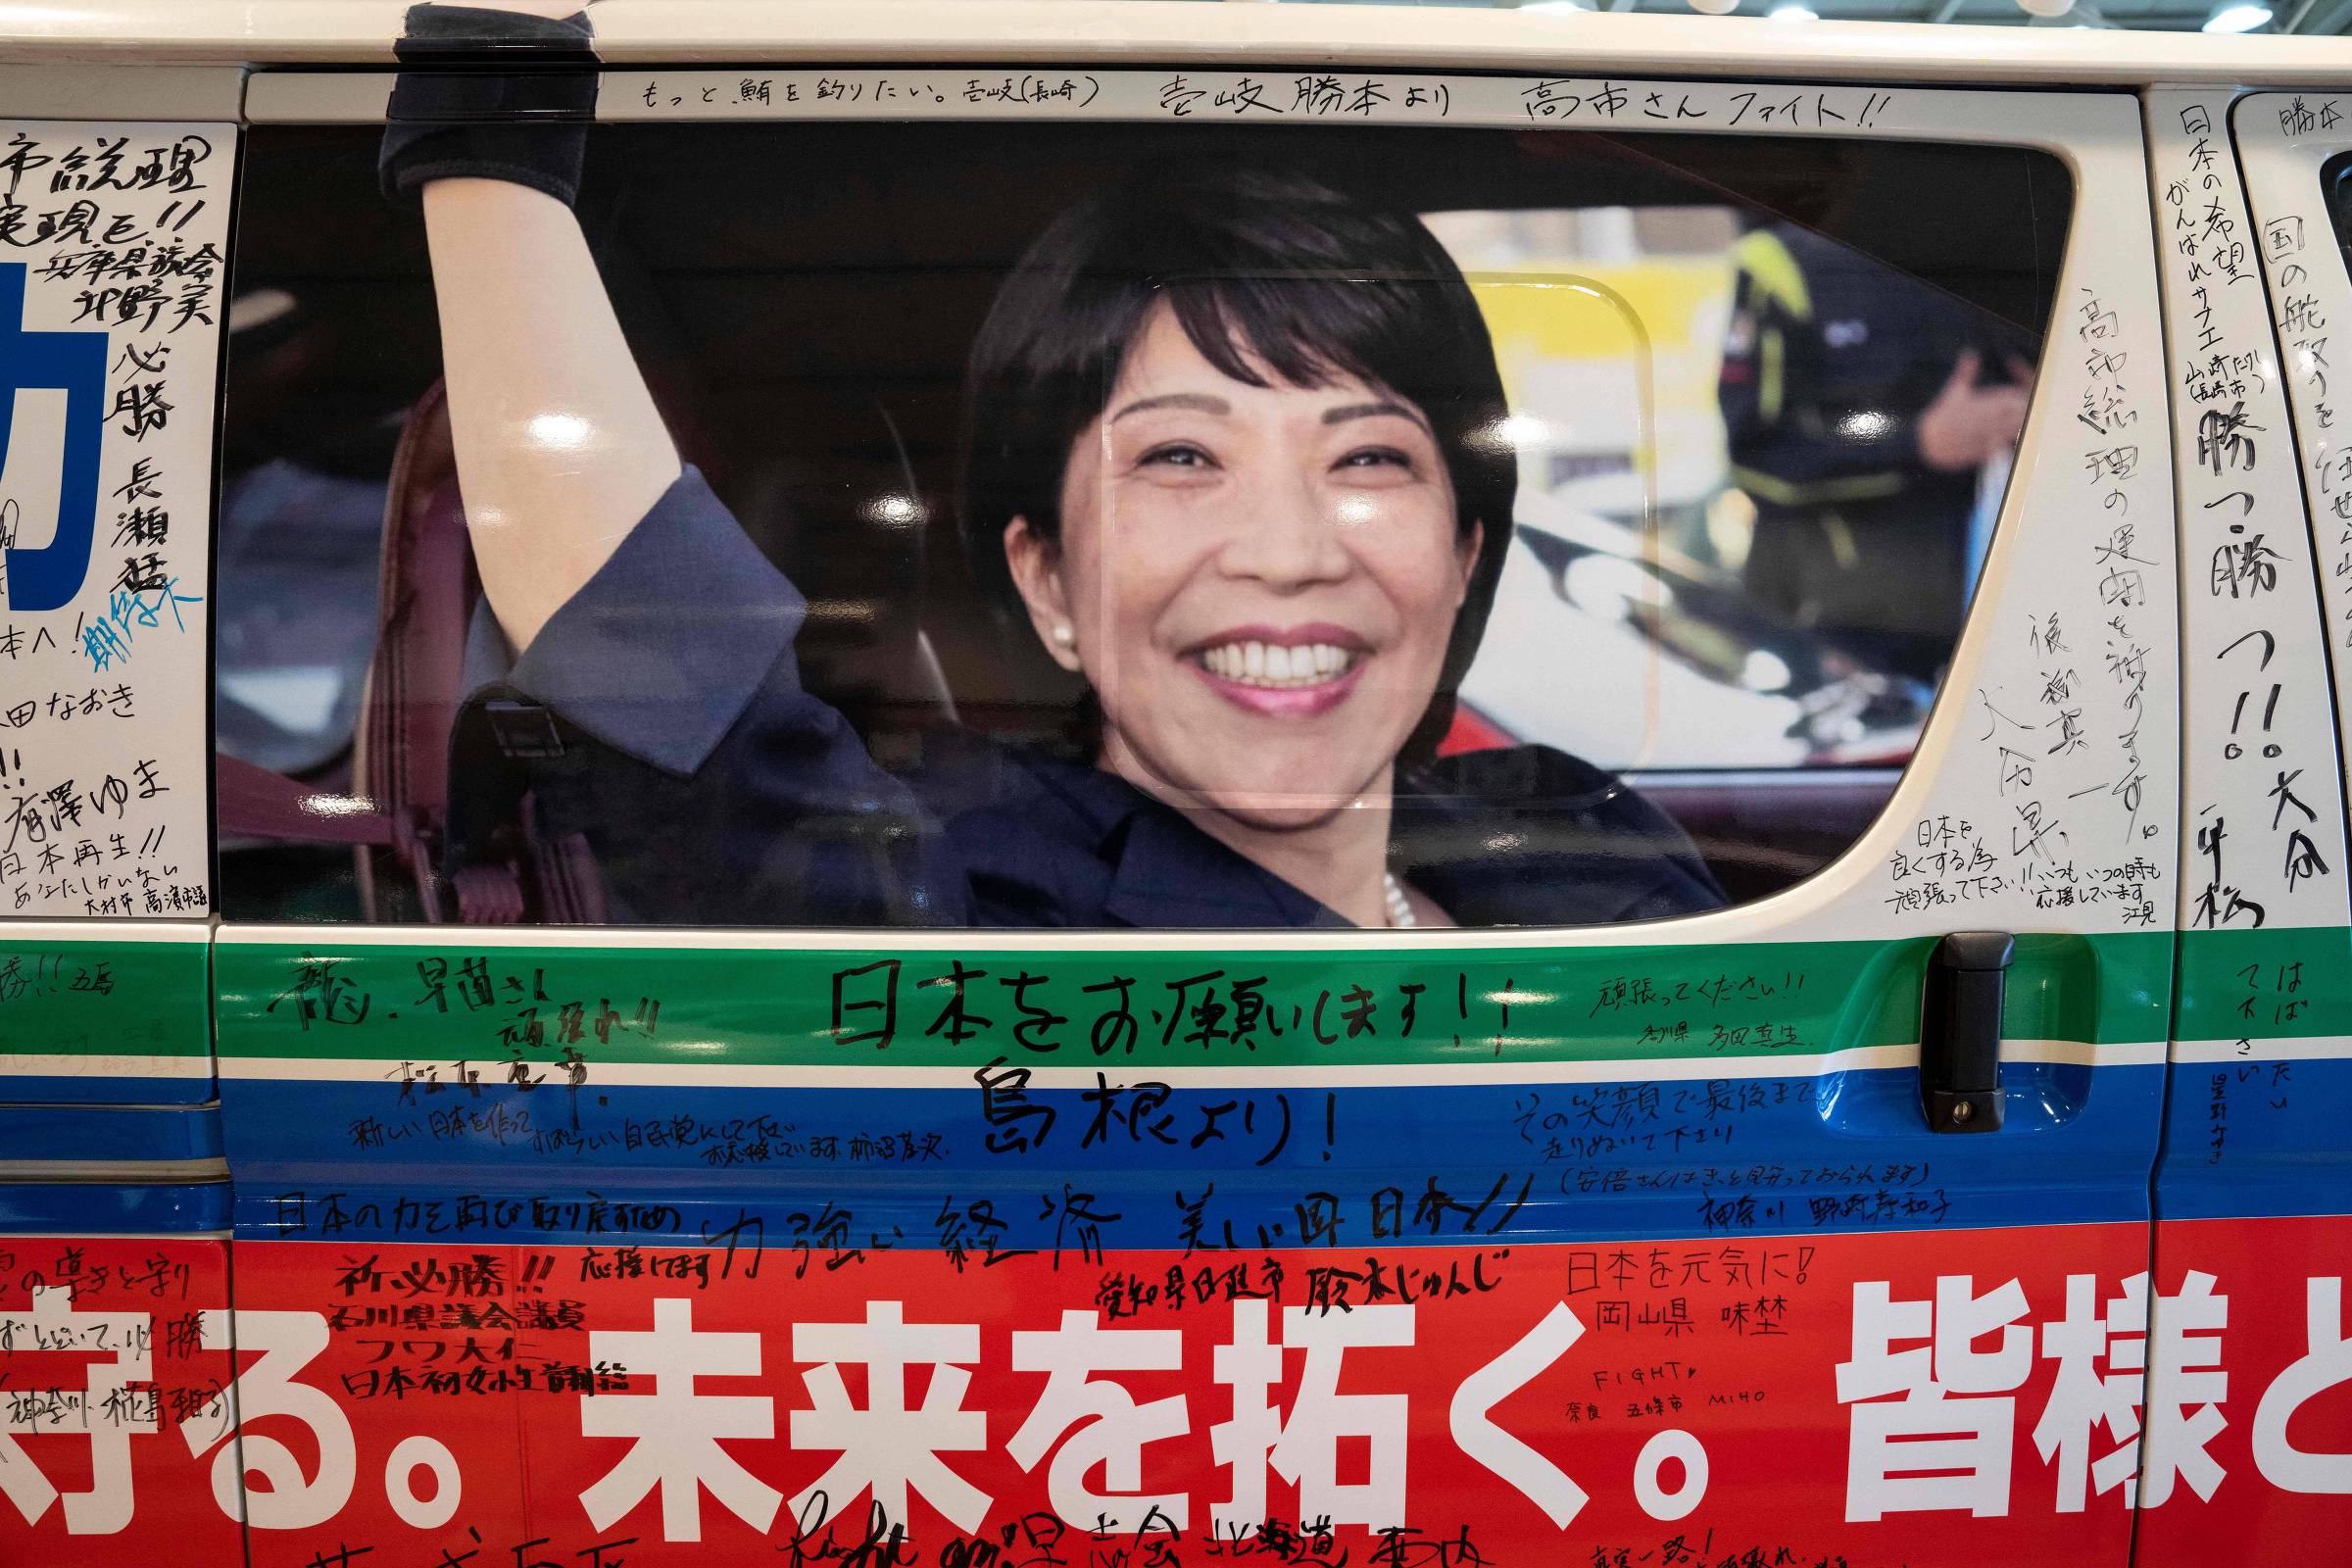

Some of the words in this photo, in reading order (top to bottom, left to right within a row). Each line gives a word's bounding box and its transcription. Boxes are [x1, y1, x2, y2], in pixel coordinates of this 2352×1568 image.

[2180, 105, 2255, 286] 日本の希望
[1595, 1297, 1694, 1339] 岡山県
